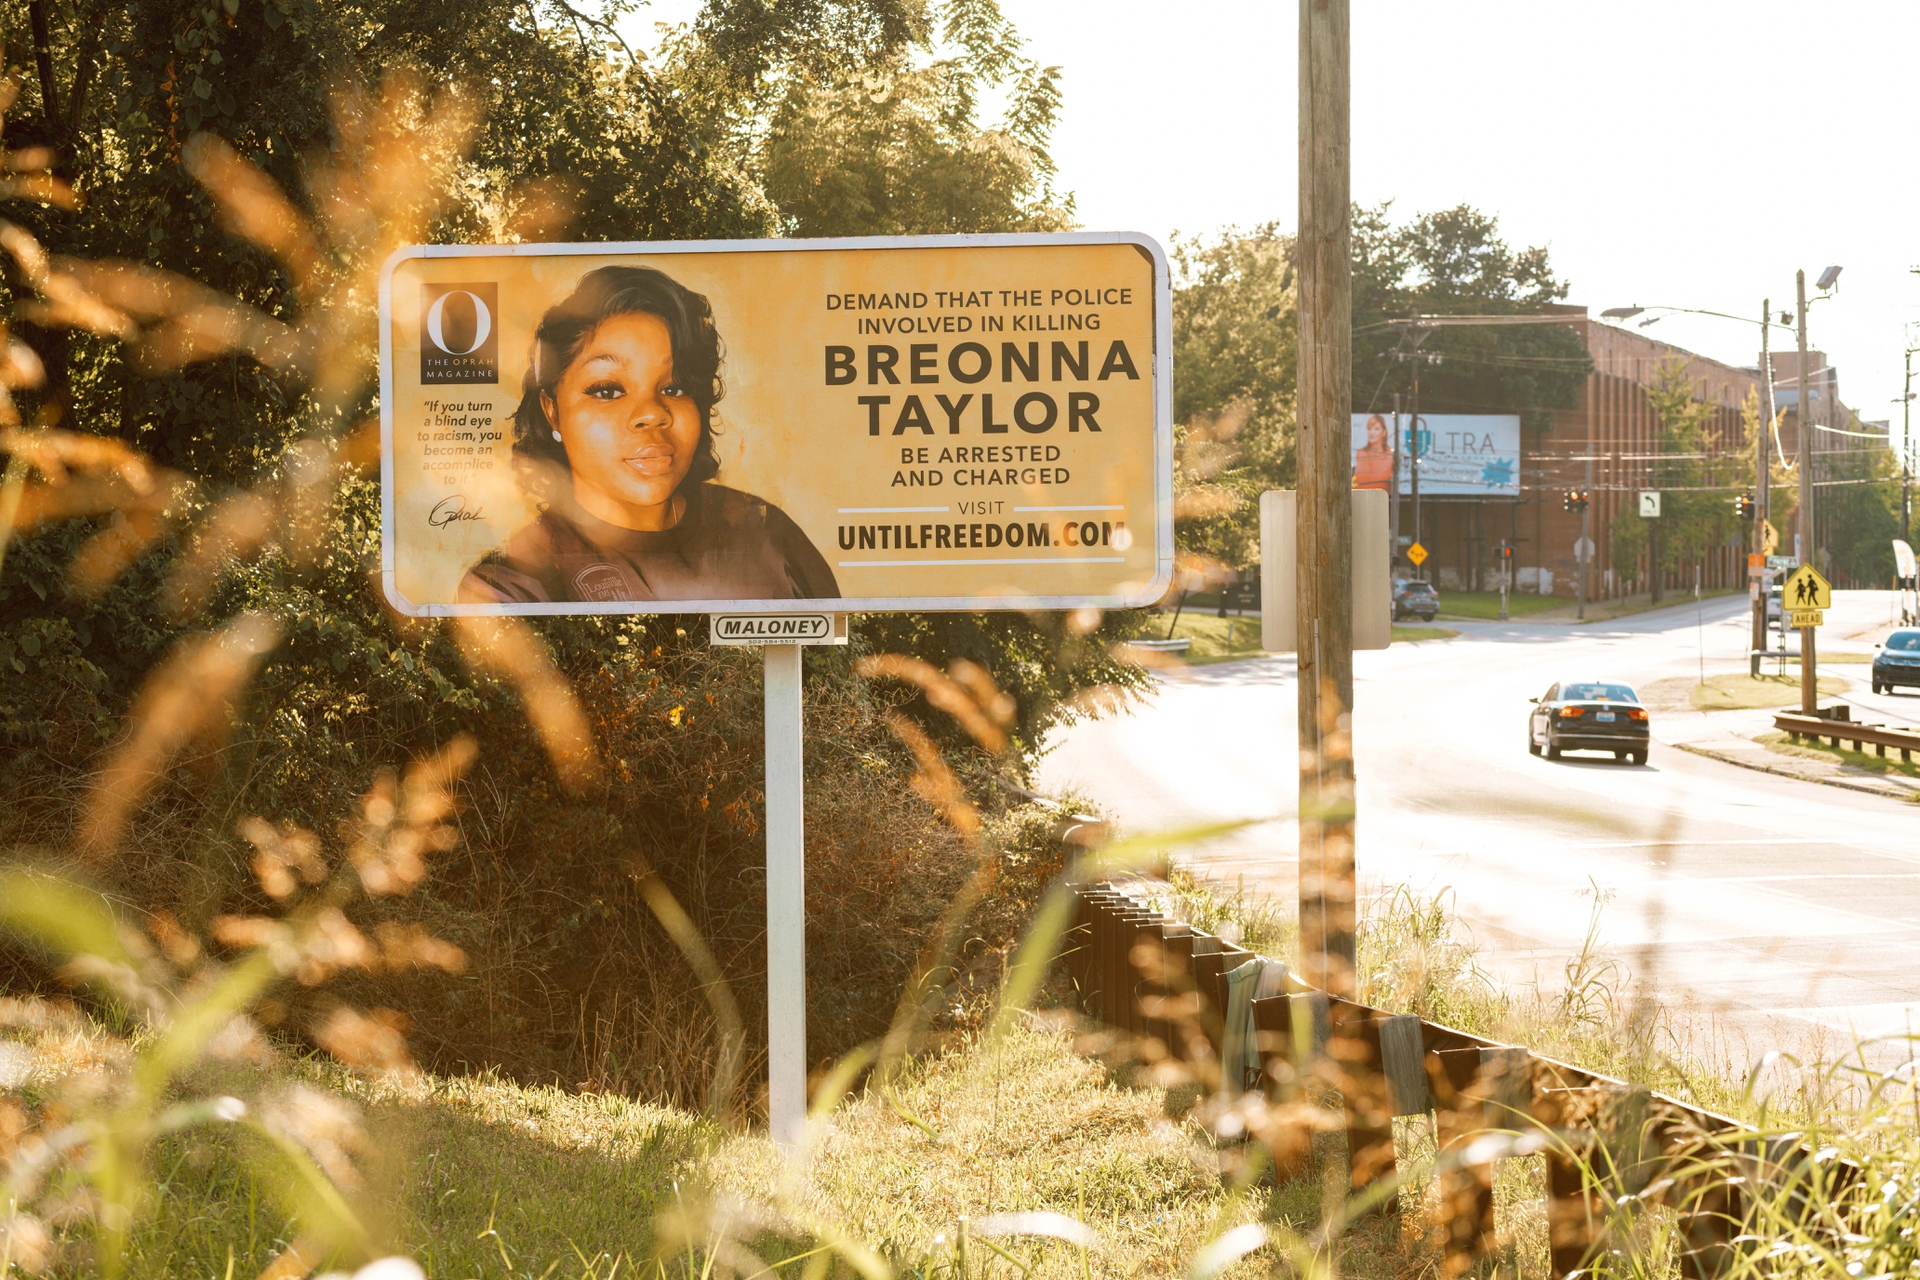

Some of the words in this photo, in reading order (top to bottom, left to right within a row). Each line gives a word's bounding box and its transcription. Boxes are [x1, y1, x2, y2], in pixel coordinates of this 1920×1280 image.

[826, 292, 928, 310] DEMAND
[934, 291, 993, 308] THAT
[999, 290, 1042, 306] THE
[1051, 288, 1133, 306] POLICE
[427, 290, 491, 355] O
[858, 316, 973, 334] INVOLVED
[981, 315, 1003, 332] IN
[1013, 313, 1100, 331] KILLING
[452, 358, 493, 366] OPRAH
[825, 340, 1141, 386] BREONNA
[426, 370, 493, 378] MAGAZINE
[441, 402, 464, 415] you
[467, 401, 492, 412] turn
[857, 391, 1102, 436] TAYLOR
[423, 418, 431, 427] a
[434, 415, 467, 427] blind
[470, 417, 492, 429] eye
[417, 431, 430, 442] to
[433, 430, 476, 442] racism,
[479, 431, 502, 443] you
[423, 444, 474, 456] become
[477, 446, 492, 455] an
[901, 447, 929, 464] BE
[938, 445, 1061, 463] ARRESTED
[422, 458, 494, 473] accomplice
[443, 475, 456, 485] to
[891, 470, 943, 487] AND
[953, 467, 1070, 486] CHARGED
[958, 501, 1004, 515] VISIT
[838, 521, 1125, 550] UNTILFREEDOM.COM
[1795, 614, 1821, 624] AHEAD
[724, 620, 823, 635] MALONEY
